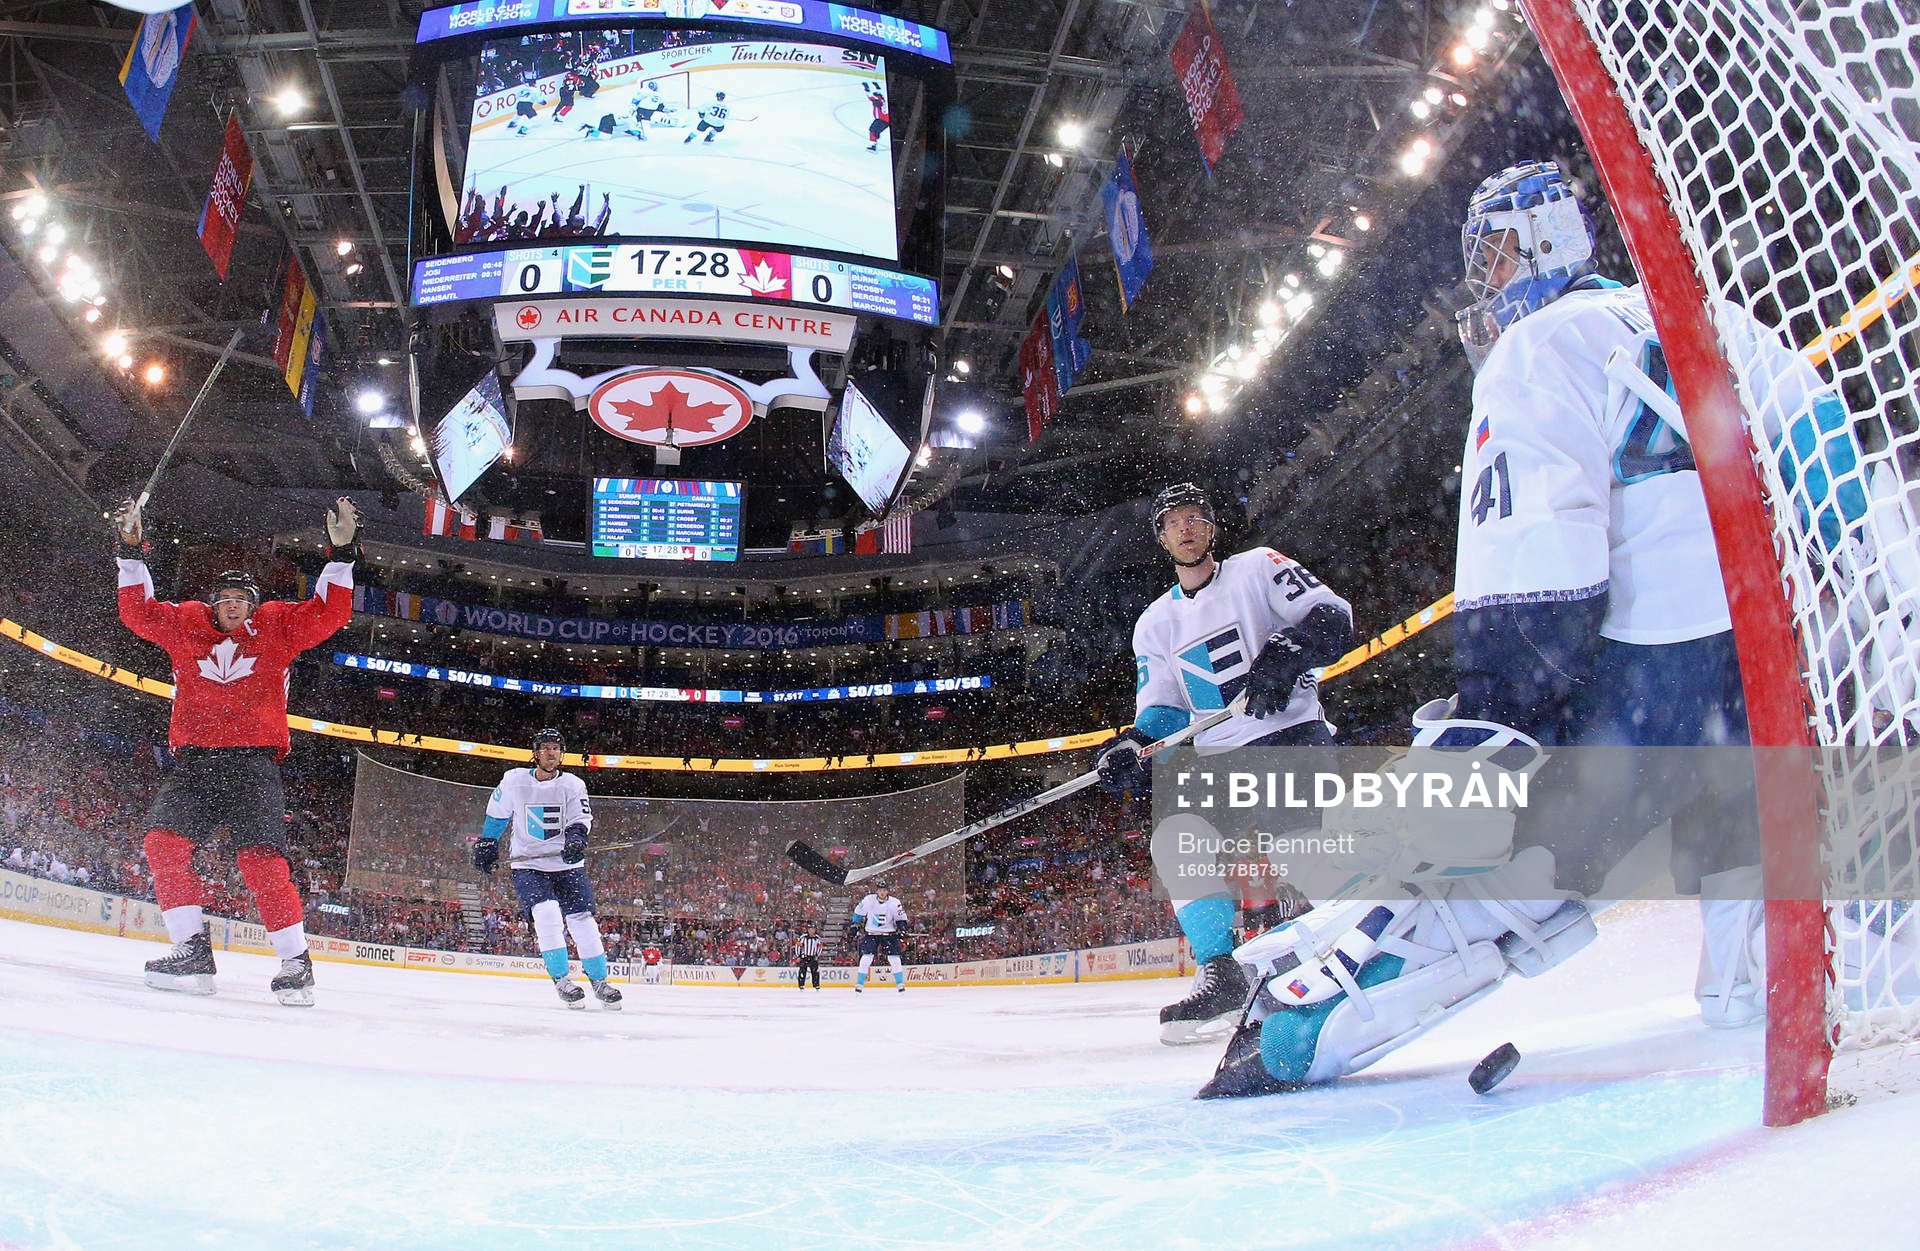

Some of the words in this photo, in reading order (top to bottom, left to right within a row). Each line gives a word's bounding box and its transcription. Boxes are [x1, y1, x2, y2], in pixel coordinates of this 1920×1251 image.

[449, 7, 495, 20] WORLD
[496, 3, 521, 13] CUP
[449, 13, 503, 29] HOCKEY
[501, 10, 532, 20] 2016
[838, 13, 887, 31] WORLD
[886, 24, 913, 38] CUP
[840, 21, 895, 41] HOCKEY
[894, 34, 922, 48] 2016
[730, 45, 758, 61] Tim
[760, 43, 824, 64] Hortons
[841, 49, 879, 65] SN
[1182, 35, 1211, 91] WORLD
[1186, 70, 1202, 103] CUP
[496, 80, 556, 111] RORS
[709, 106, 728, 119] 36
[1191, 93, 1212, 131] 2016
[218, 161, 232, 187] CUP
[222, 147, 244, 195] WORLD
[210, 184, 225, 217] 2016
[215, 170, 240, 223] HOCKEY
[424, 255, 474, 268] SEIDENBERG
[508, 249, 544, 262] SHOTS
[552, 249, 559, 257] 4
[630, 249, 730, 277] 17:28
[423, 268, 441, 277] JOSI
[796, 257, 830, 272] SHOTS
[837, 264, 844, 272] 0
[851, 264, 905, 281] PIETRANGELO
[422, 272, 478, 285] NIEDERREITER
[481, 270, 502, 278] 00:10
[520, 264, 542, 292] 0
[652, 278, 688, 290] PER
[851, 274, 879, 285] BURNS
[420, 284, 453, 295] HANSEN
[812, 275, 833, 302] 0
[852, 283, 885, 295] CROSBY
[419, 293, 459, 304] DRAISAITL
[852, 292, 897, 306] BERGERON
[912, 294, 931, 304] 00:21
[853, 301, 897, 315] MARCHAND
[556, 308, 599, 324] AIR
[612, 307, 722, 326] CANADA
[734, 312, 833, 337] CENTRE
[913, 312, 932, 322] 00:21
[1470, 451, 1513, 528] 41
[625, 548, 631, 557] 0
[701, 551, 708, 559] 0
[1273, 565, 1324, 602] 36
[244, 618, 258, 637] C
[464, 606, 554, 637] WORLD
[558, 620, 610, 639] CUP
[631, 623, 737, 644] HOCKEY
[742, 625, 799, 646] 2016
[805, 624, 866, 638] TORONTO
[366, 658, 412, 675] 50/50
[448, 670, 492, 687] 50/50
[935, 676, 981, 692] 50/50
[532, 683, 562, 695] $7,517
[773, 692, 803, 703] $7,517
[848, 684, 893, 698] 50/50
[15, 883, 39, 904] CUP
[355, 945, 396, 962] sonnet
[1127, 949, 1147, 967] VISA
[1148, 953, 1174, 965] Checkout
[510, 960, 525, 968] AIR
[526, 961, 546, 970] CAN
[673, 969, 717, 981] CANADIAN
[907, 967, 922, 981] Tim
